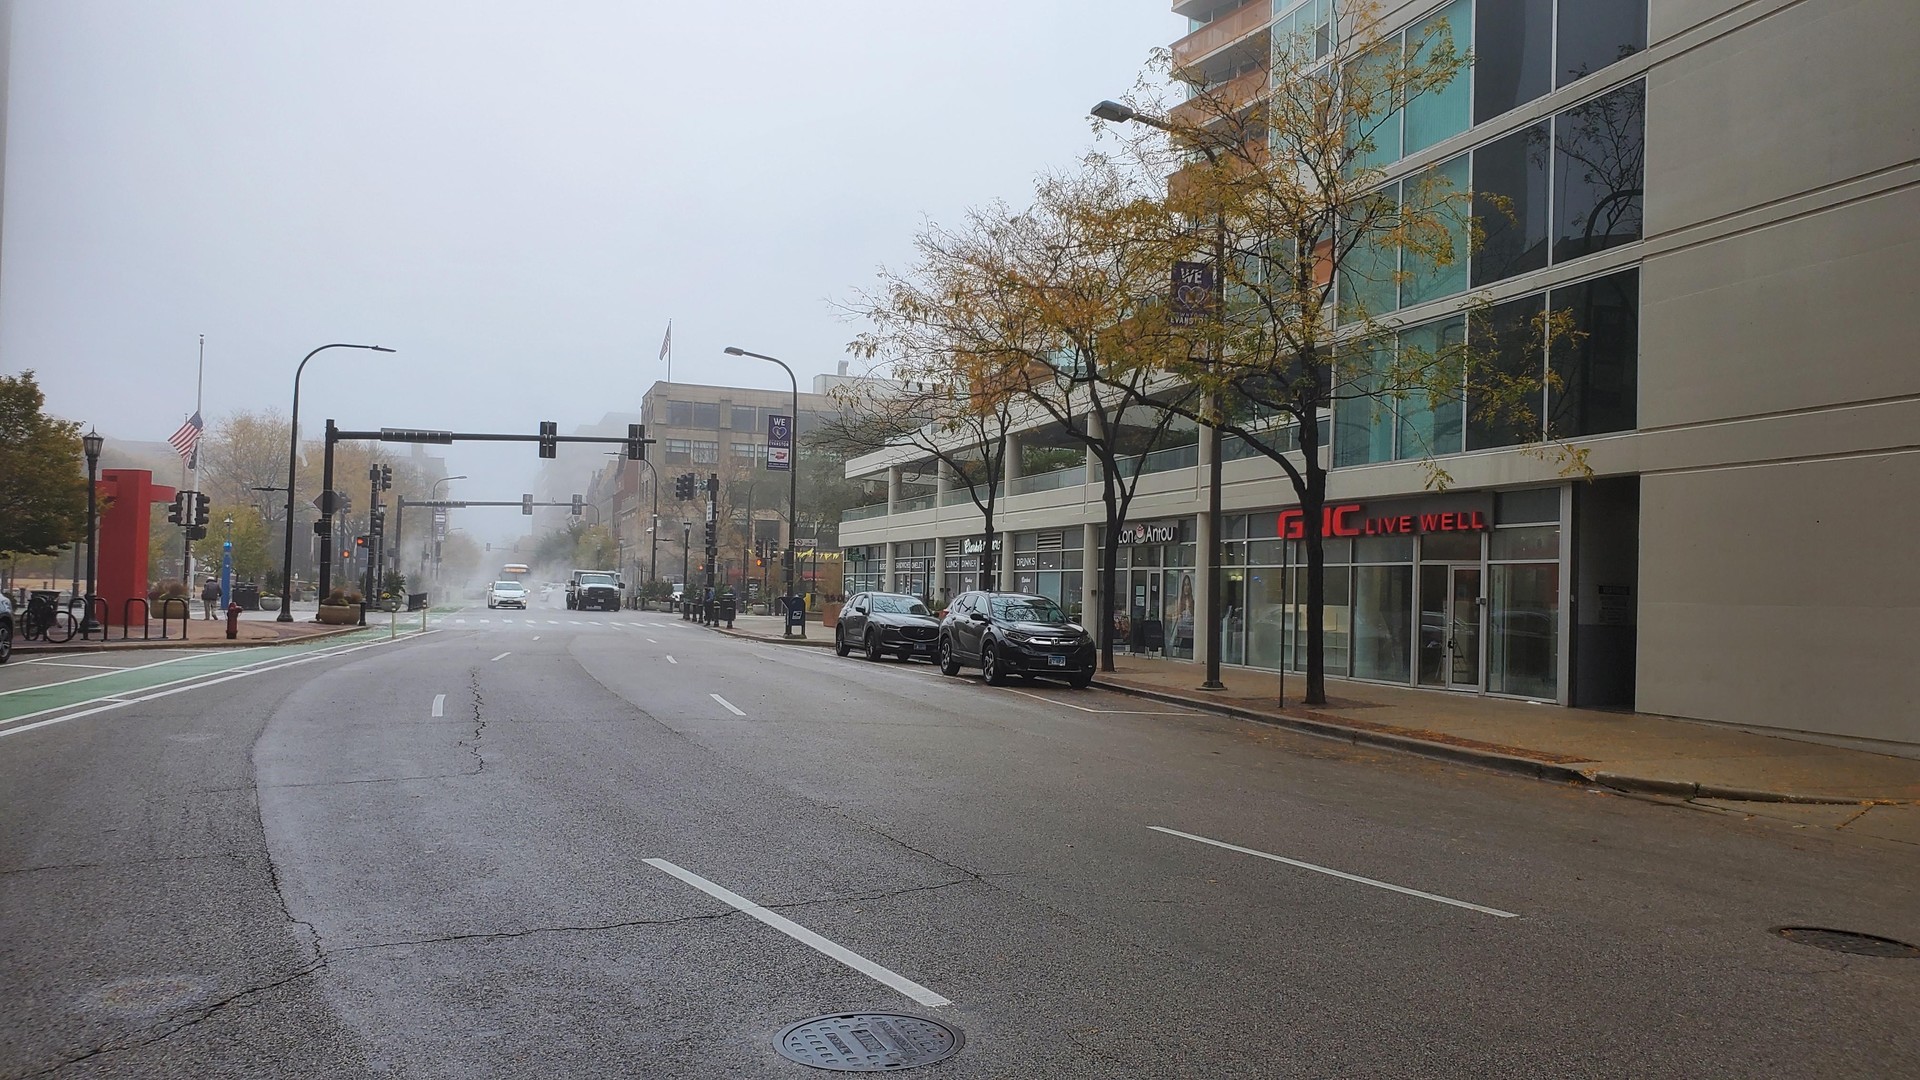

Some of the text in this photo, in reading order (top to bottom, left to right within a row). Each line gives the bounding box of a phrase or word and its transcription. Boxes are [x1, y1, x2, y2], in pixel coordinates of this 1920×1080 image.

[1181, 268, 1202, 283] WE
[773, 417, 786, 426] WE
[1366, 516, 1411, 534] LIVE
[1420, 511, 1484, 531] WELL
[1016, 557, 1036, 567] DRINKS
